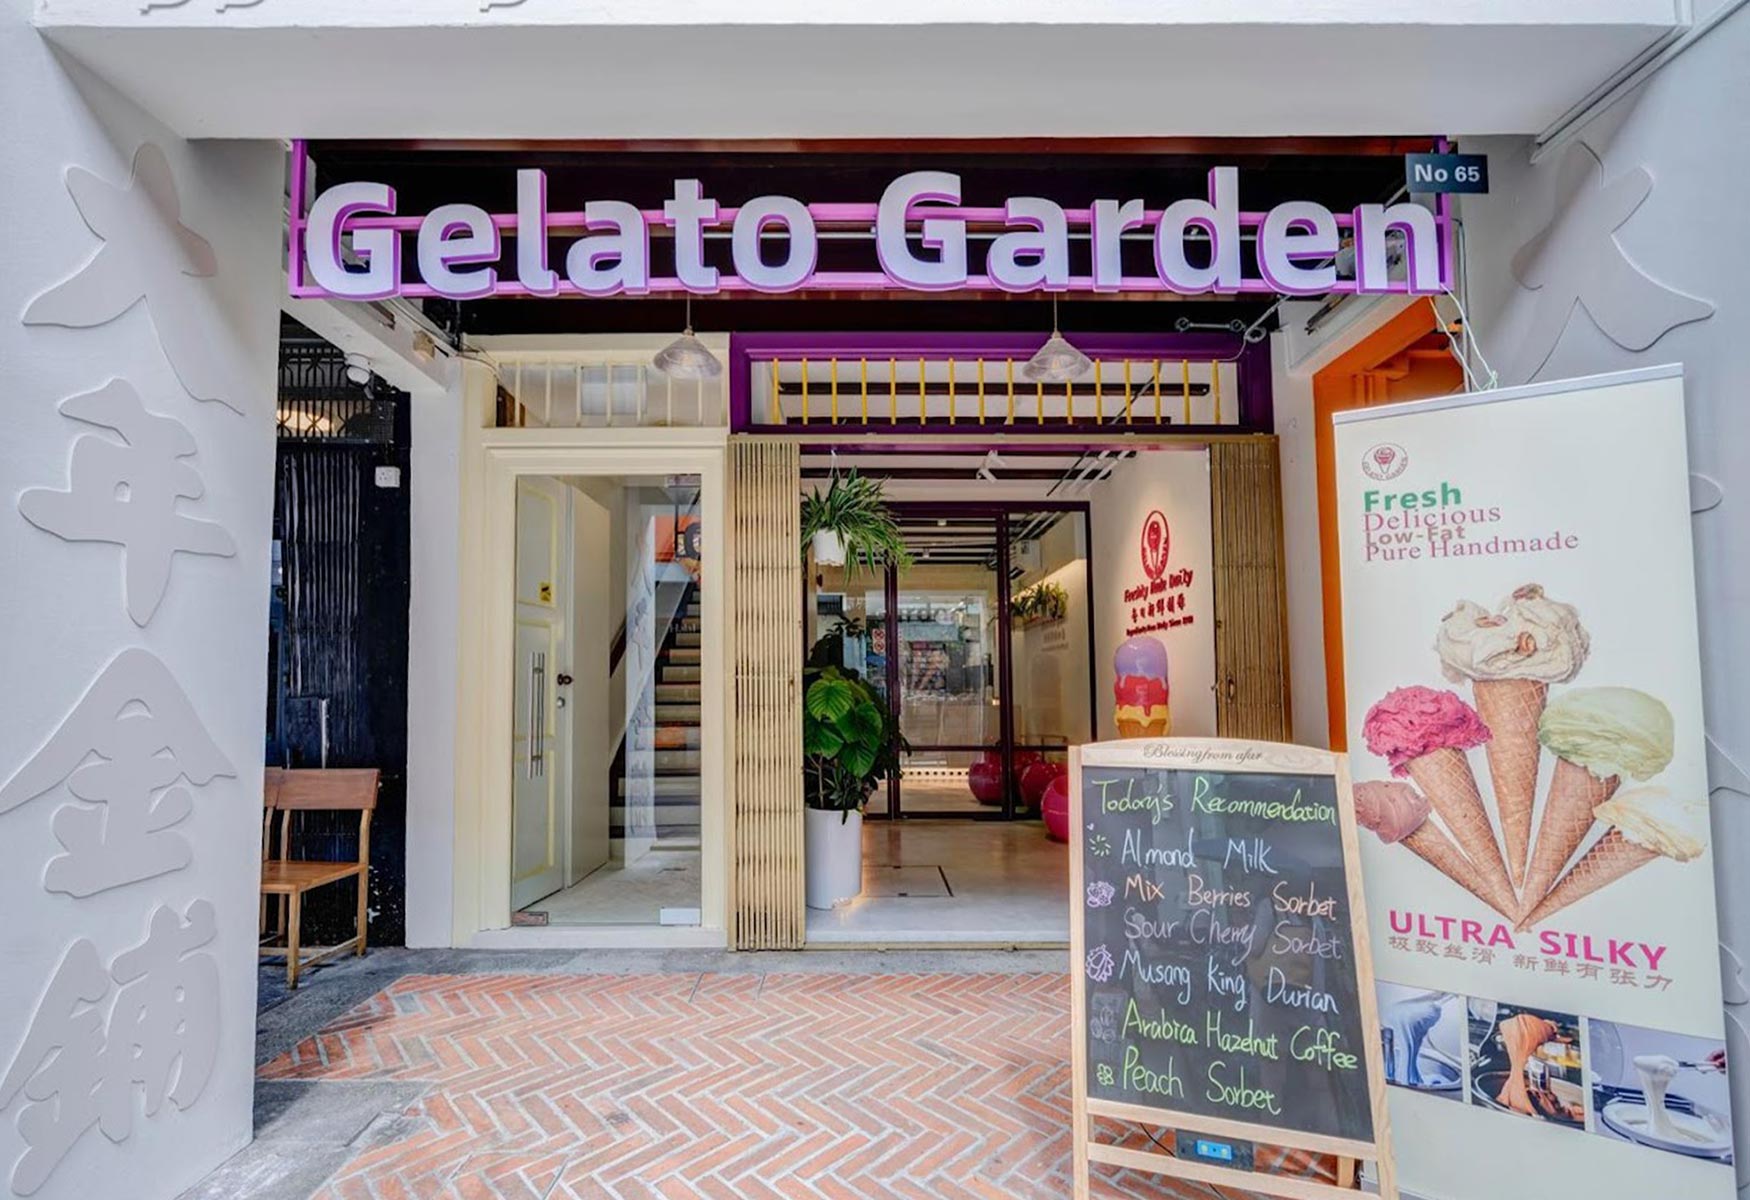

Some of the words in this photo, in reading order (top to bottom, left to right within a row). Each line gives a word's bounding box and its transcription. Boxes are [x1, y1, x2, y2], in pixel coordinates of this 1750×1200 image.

[1414, 163, 1448, 183] No
[1454, 165, 1480, 182] 65
[306, 168, 819, 300] Gelato
[876, 166, 1441, 295] Garden
[1364, 482, 1462, 512] Fresh
[1364, 506, 1501, 532] Delicious
[1365, 525, 1466, 546] Low-Fat
[1365, 544, 1421, 562] Pure
[1430, 531, 1579, 558] Handmade
[1199, 747, 1233, 762] from
[1235, 748, 1263, 765] afar
[1092, 777, 1174, 824] Today's
[1190, 776, 1336, 825] Recommendation
[1121, 827, 1196, 868] Almond
[1224, 838, 1278, 874] Milk
[1124, 874, 1165, 905] Mix
[1188, 874, 1251, 907] Berries
[1272, 881, 1336, 920] Sorbet
[1123, 907, 1180, 939] Sour
[1190, 909, 1257, 966] Cherry
[1271, 920, 1342, 959] Sorbet
[1389, 909, 1516, 949] ULTRA
[1539, 930, 1666, 970] SILKY
[1119, 949, 1191, 1005] Musang
[1267, 966, 1339, 1014] Durian
[1121, 998, 1198, 1044] Arabica
[1206, 1010, 1278, 1060] Hazelnut
[1290, 1025, 1358, 1070] Coffee
[1122, 1045, 1185, 1098] Peach
[1206, 1061, 1281, 1115] Sorbet
